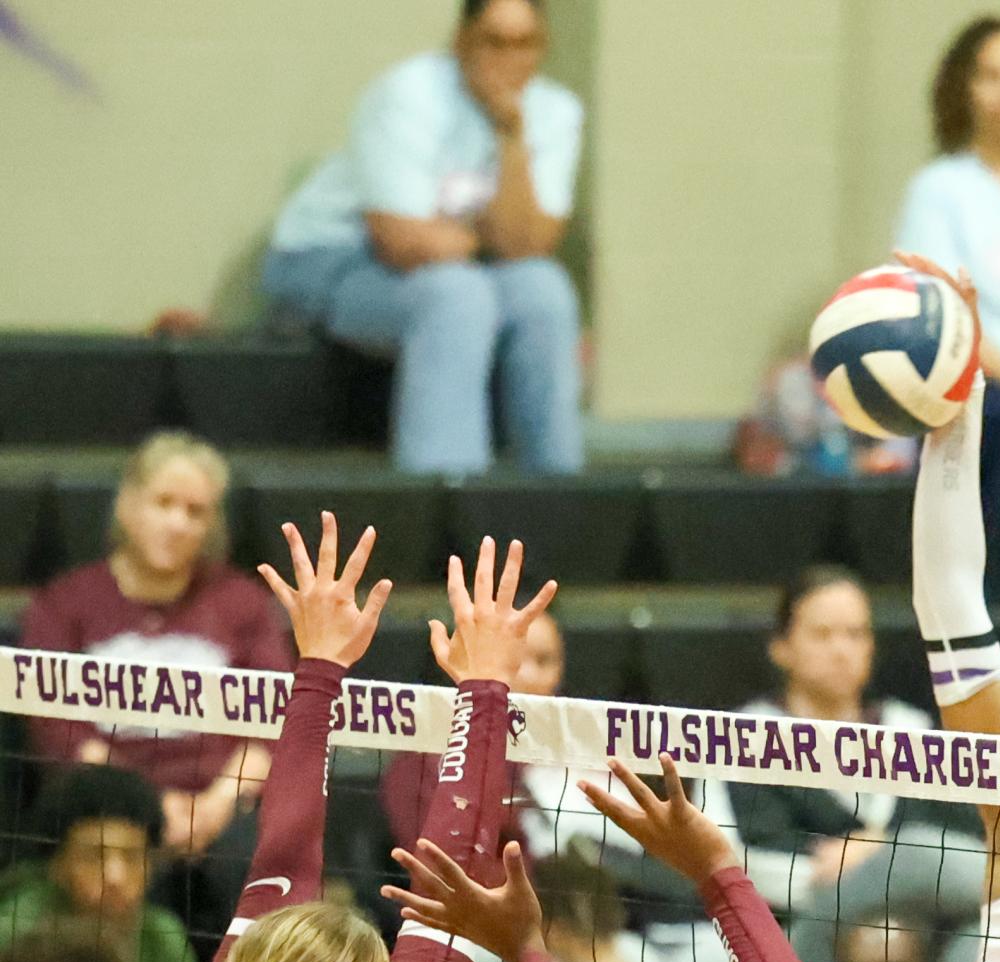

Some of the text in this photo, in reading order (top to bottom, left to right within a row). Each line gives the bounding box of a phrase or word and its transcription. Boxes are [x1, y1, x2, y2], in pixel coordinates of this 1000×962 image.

[14, 655, 416, 736] FULSHEAR CHAERS
[606, 708, 821, 773] FULSHEAR
